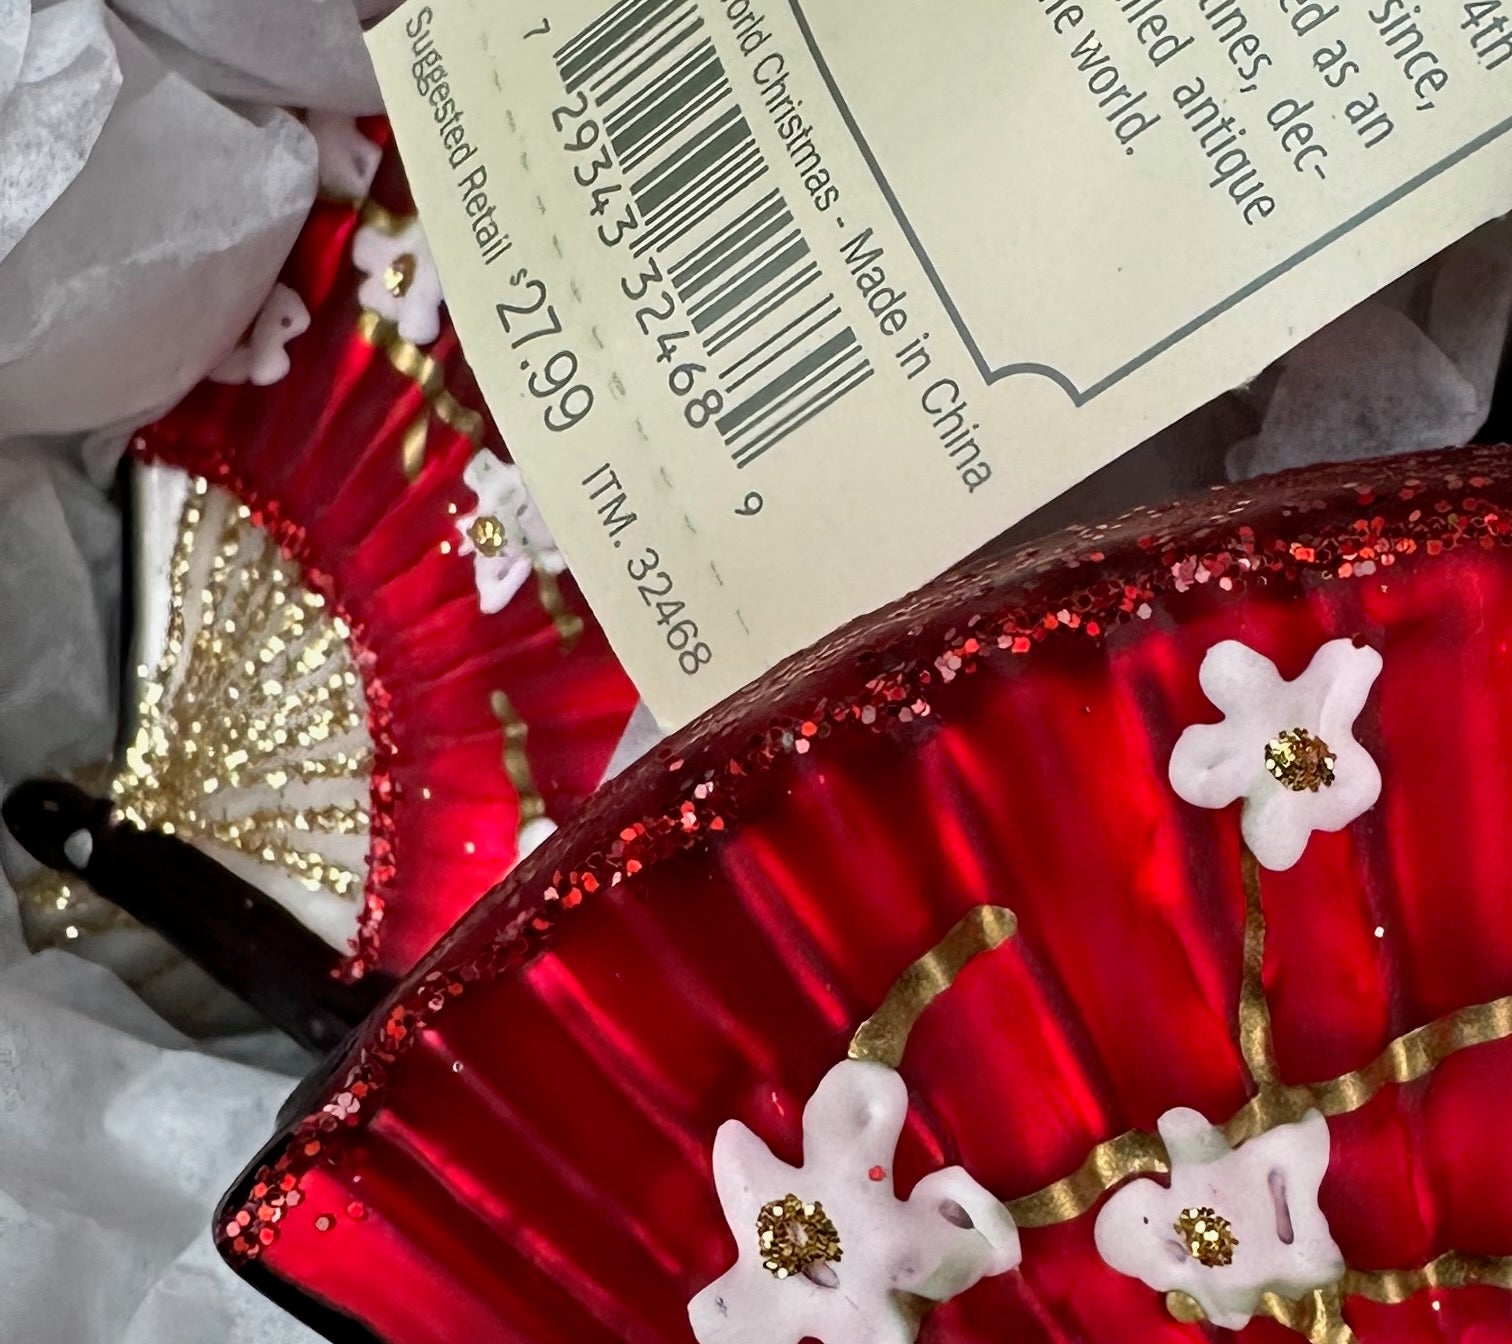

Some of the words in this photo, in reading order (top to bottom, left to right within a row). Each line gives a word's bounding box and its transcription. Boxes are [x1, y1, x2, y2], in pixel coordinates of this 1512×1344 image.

[1069, 28, 1163, 157] world.
[1171, 75, 1277, 227] antique
[1265, 97, 1329, 181] dec-
[1311, 38, 1361, 89] as
[1343, 90, 1396, 150] an
[404, 5, 480, 171] Suggested
[456, 163, 514, 267] Retail
[494, 267, 596, 434] $27.99
[580, 461, 639, 549] ITM.
[626, 546, 714, 677] 32468
[522, 16, 552, 41] 7
[550, 89, 640, 249] 29343
[619, 255, 725, 430] 32468
[733, 490, 765, 517] 9
[751, 51, 841, 214] Christmas
[838, 226, 909, 338] Made
[894, 331, 933, 381] in
[920, 377, 993, 495] China
